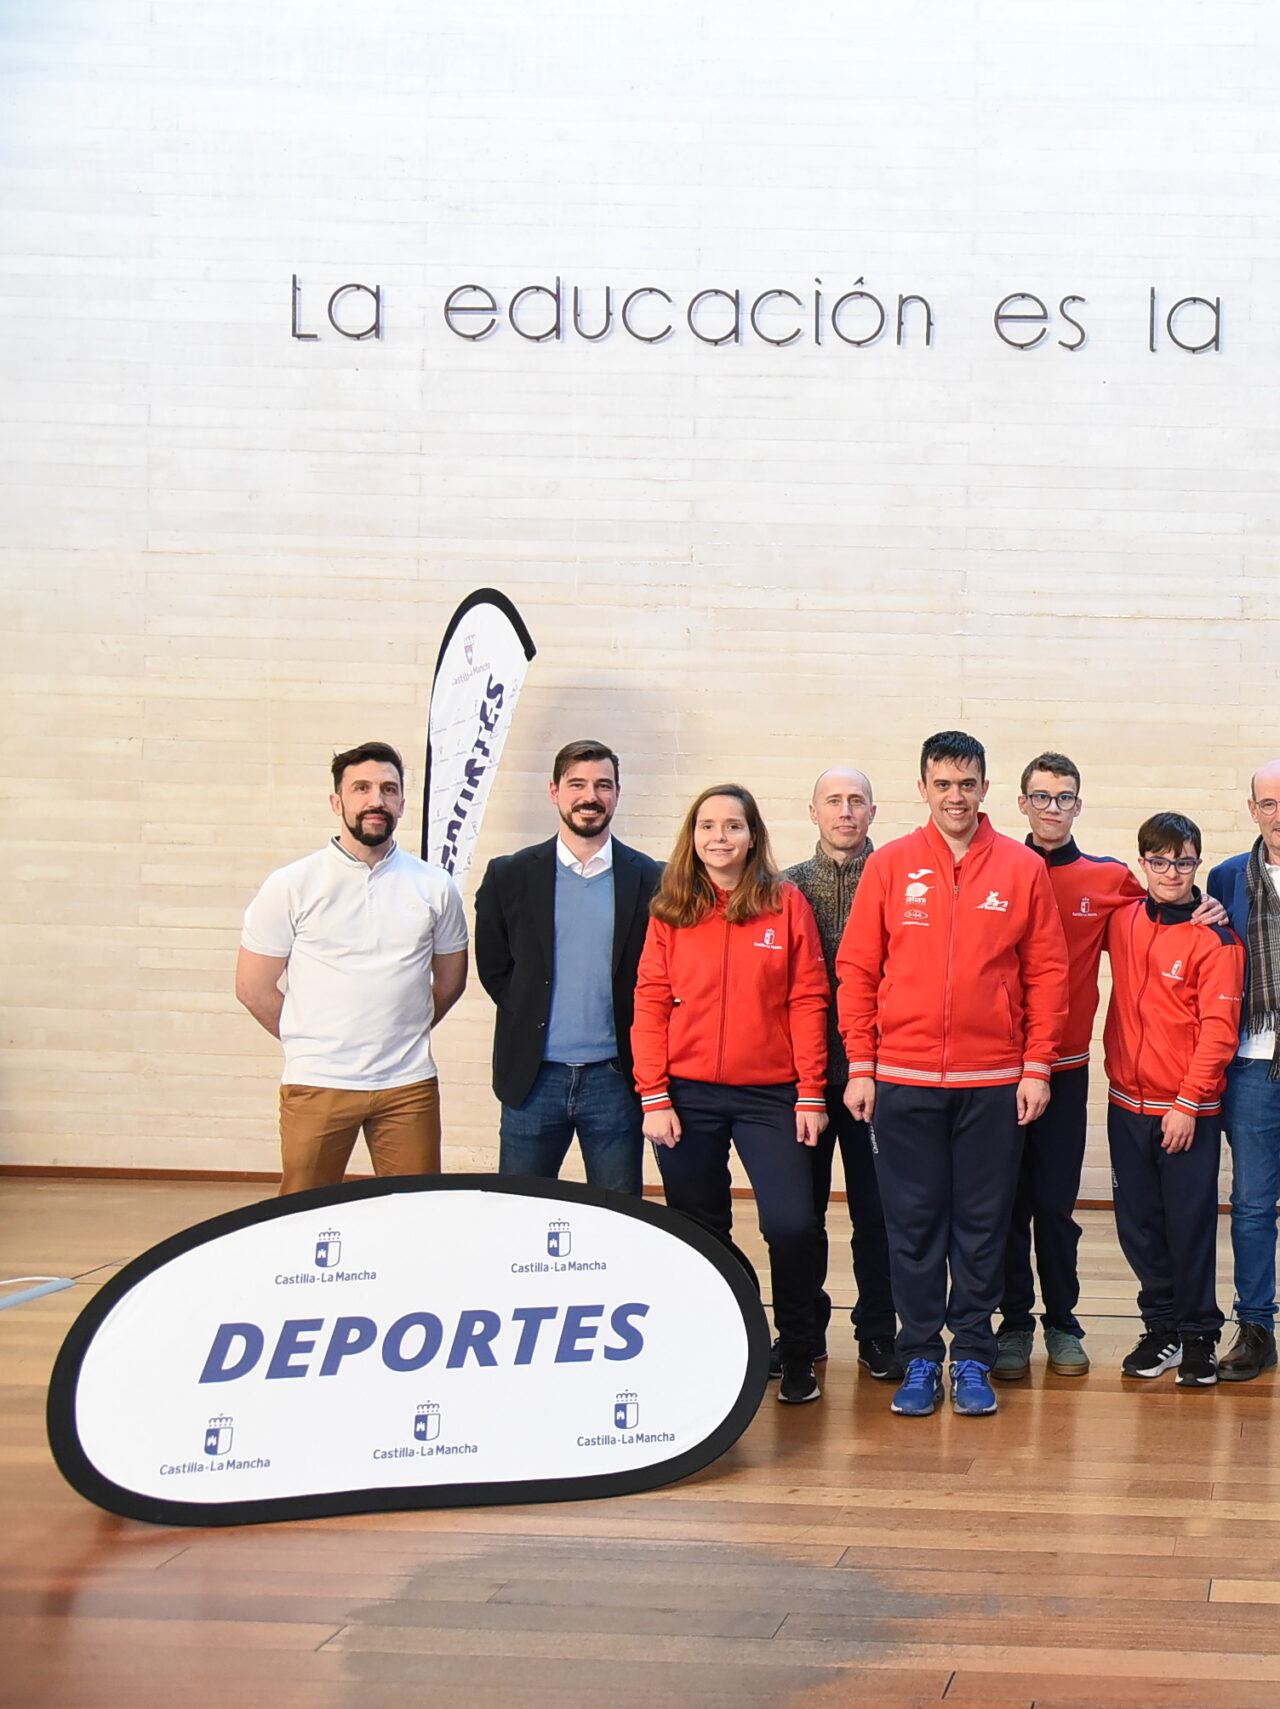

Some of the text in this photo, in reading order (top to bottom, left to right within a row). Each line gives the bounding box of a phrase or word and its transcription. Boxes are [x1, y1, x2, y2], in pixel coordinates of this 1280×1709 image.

[292, 274, 379, 340] La
[444, 276, 934, 346] educación
[994, 293, 1085, 351] es
[1150, 288, 1220, 354] la
[510, 1260, 607, 1274] Castilla-La Mancha
[274, 1270, 377, 1285] Castilla-La Mancha
[198, 1302, 651, 1384] DEPORTES
[577, 1431, 676, 1447] Castilla-La Mancha
[372, 1443, 478, 1459] Castilla-La Mancha
[159, 1457, 271, 1476] Castilla-La Mancha
